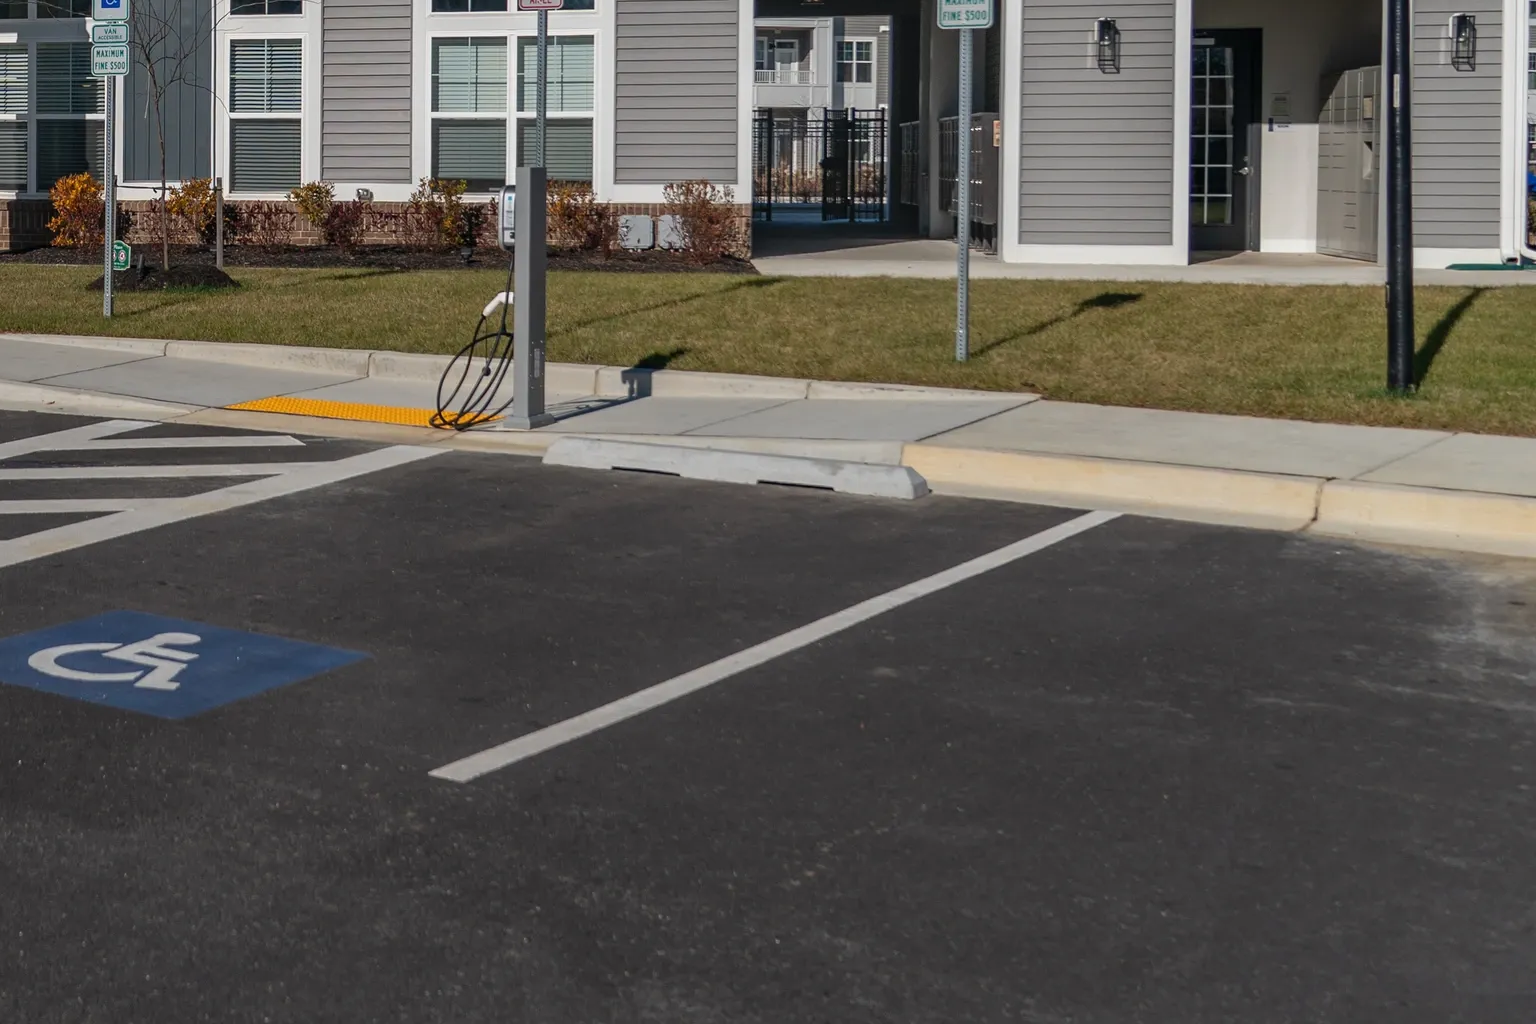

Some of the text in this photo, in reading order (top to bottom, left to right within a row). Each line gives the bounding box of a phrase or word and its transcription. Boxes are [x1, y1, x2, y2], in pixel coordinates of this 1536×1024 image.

[943, 10, 987, 21] FINE $500
[96, 49, 124, 57] MAXIMUM
[95, 62, 126, 70] FINE $500
